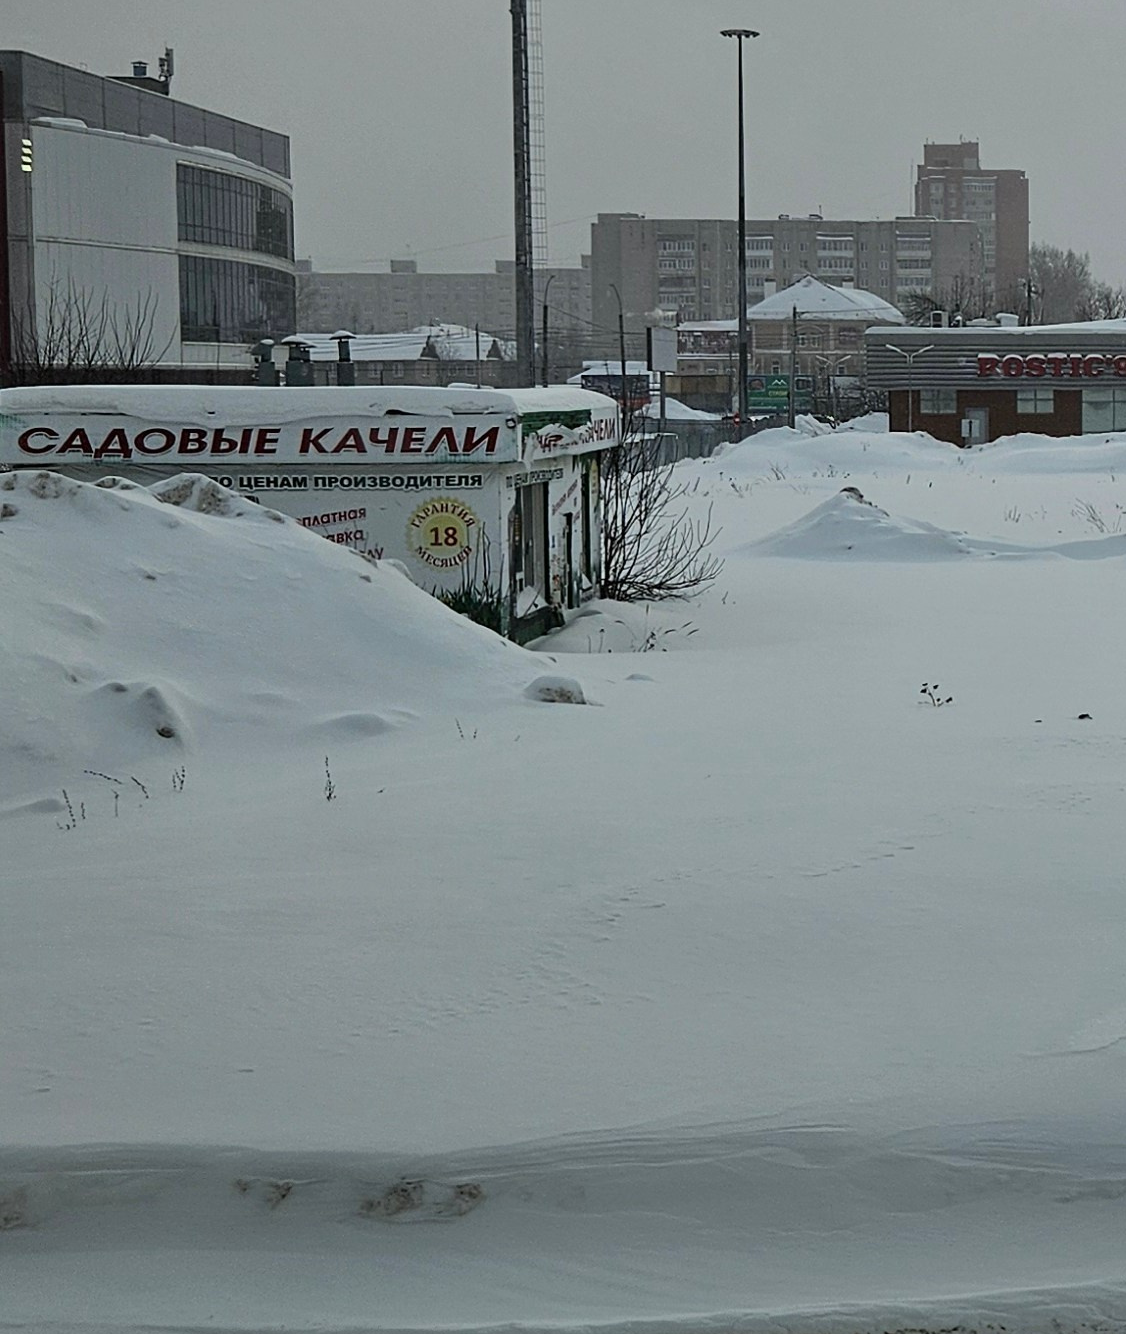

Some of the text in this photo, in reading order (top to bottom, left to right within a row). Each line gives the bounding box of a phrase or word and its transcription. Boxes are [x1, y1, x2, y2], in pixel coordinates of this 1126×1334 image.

[18, 427, 281, 459] САДОВЫЕ
[299, 426, 500, 454] КАЧЕЛИ
[239, 476, 307, 490] ЦЕНАМ
[314, 475, 483, 490] ПРОИЗВОДИТЕЛЯ
[411, 503, 476, 528] ГАРАНТИЯ
[430, 527, 458, 547] 18
[416, 545, 473, 568] МЕСЯЦЕВ
